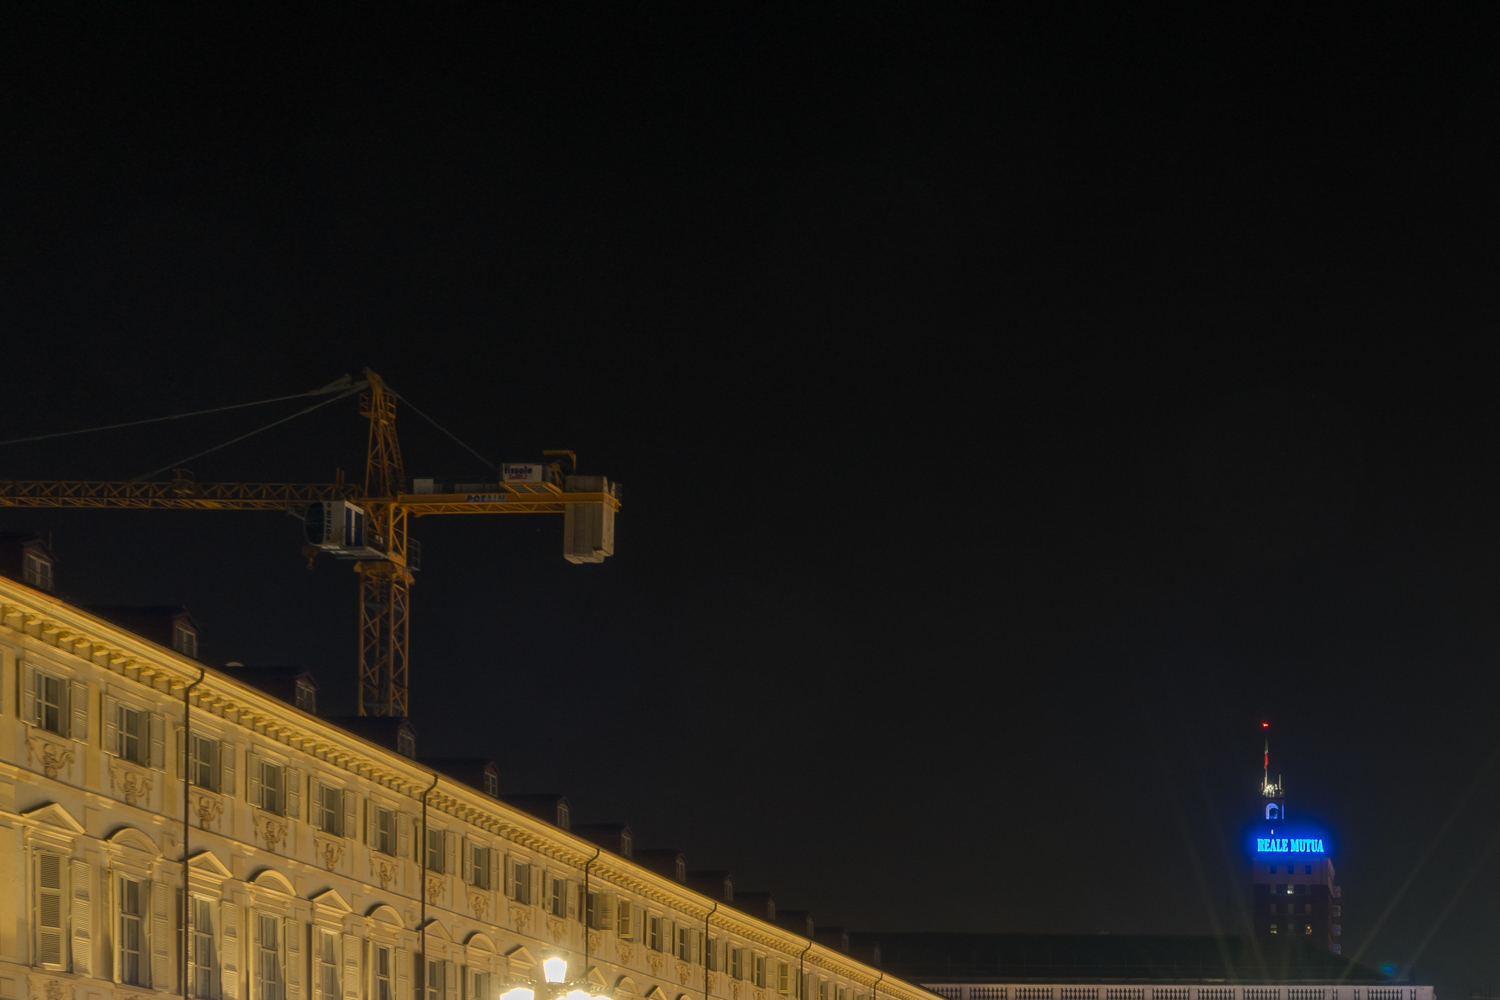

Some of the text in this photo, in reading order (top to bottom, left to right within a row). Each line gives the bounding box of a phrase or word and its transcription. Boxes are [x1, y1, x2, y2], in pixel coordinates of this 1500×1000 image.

[465, 494, 507, 503] POTAIN
[1257, 838, 1324, 852] REALE MUTUA
